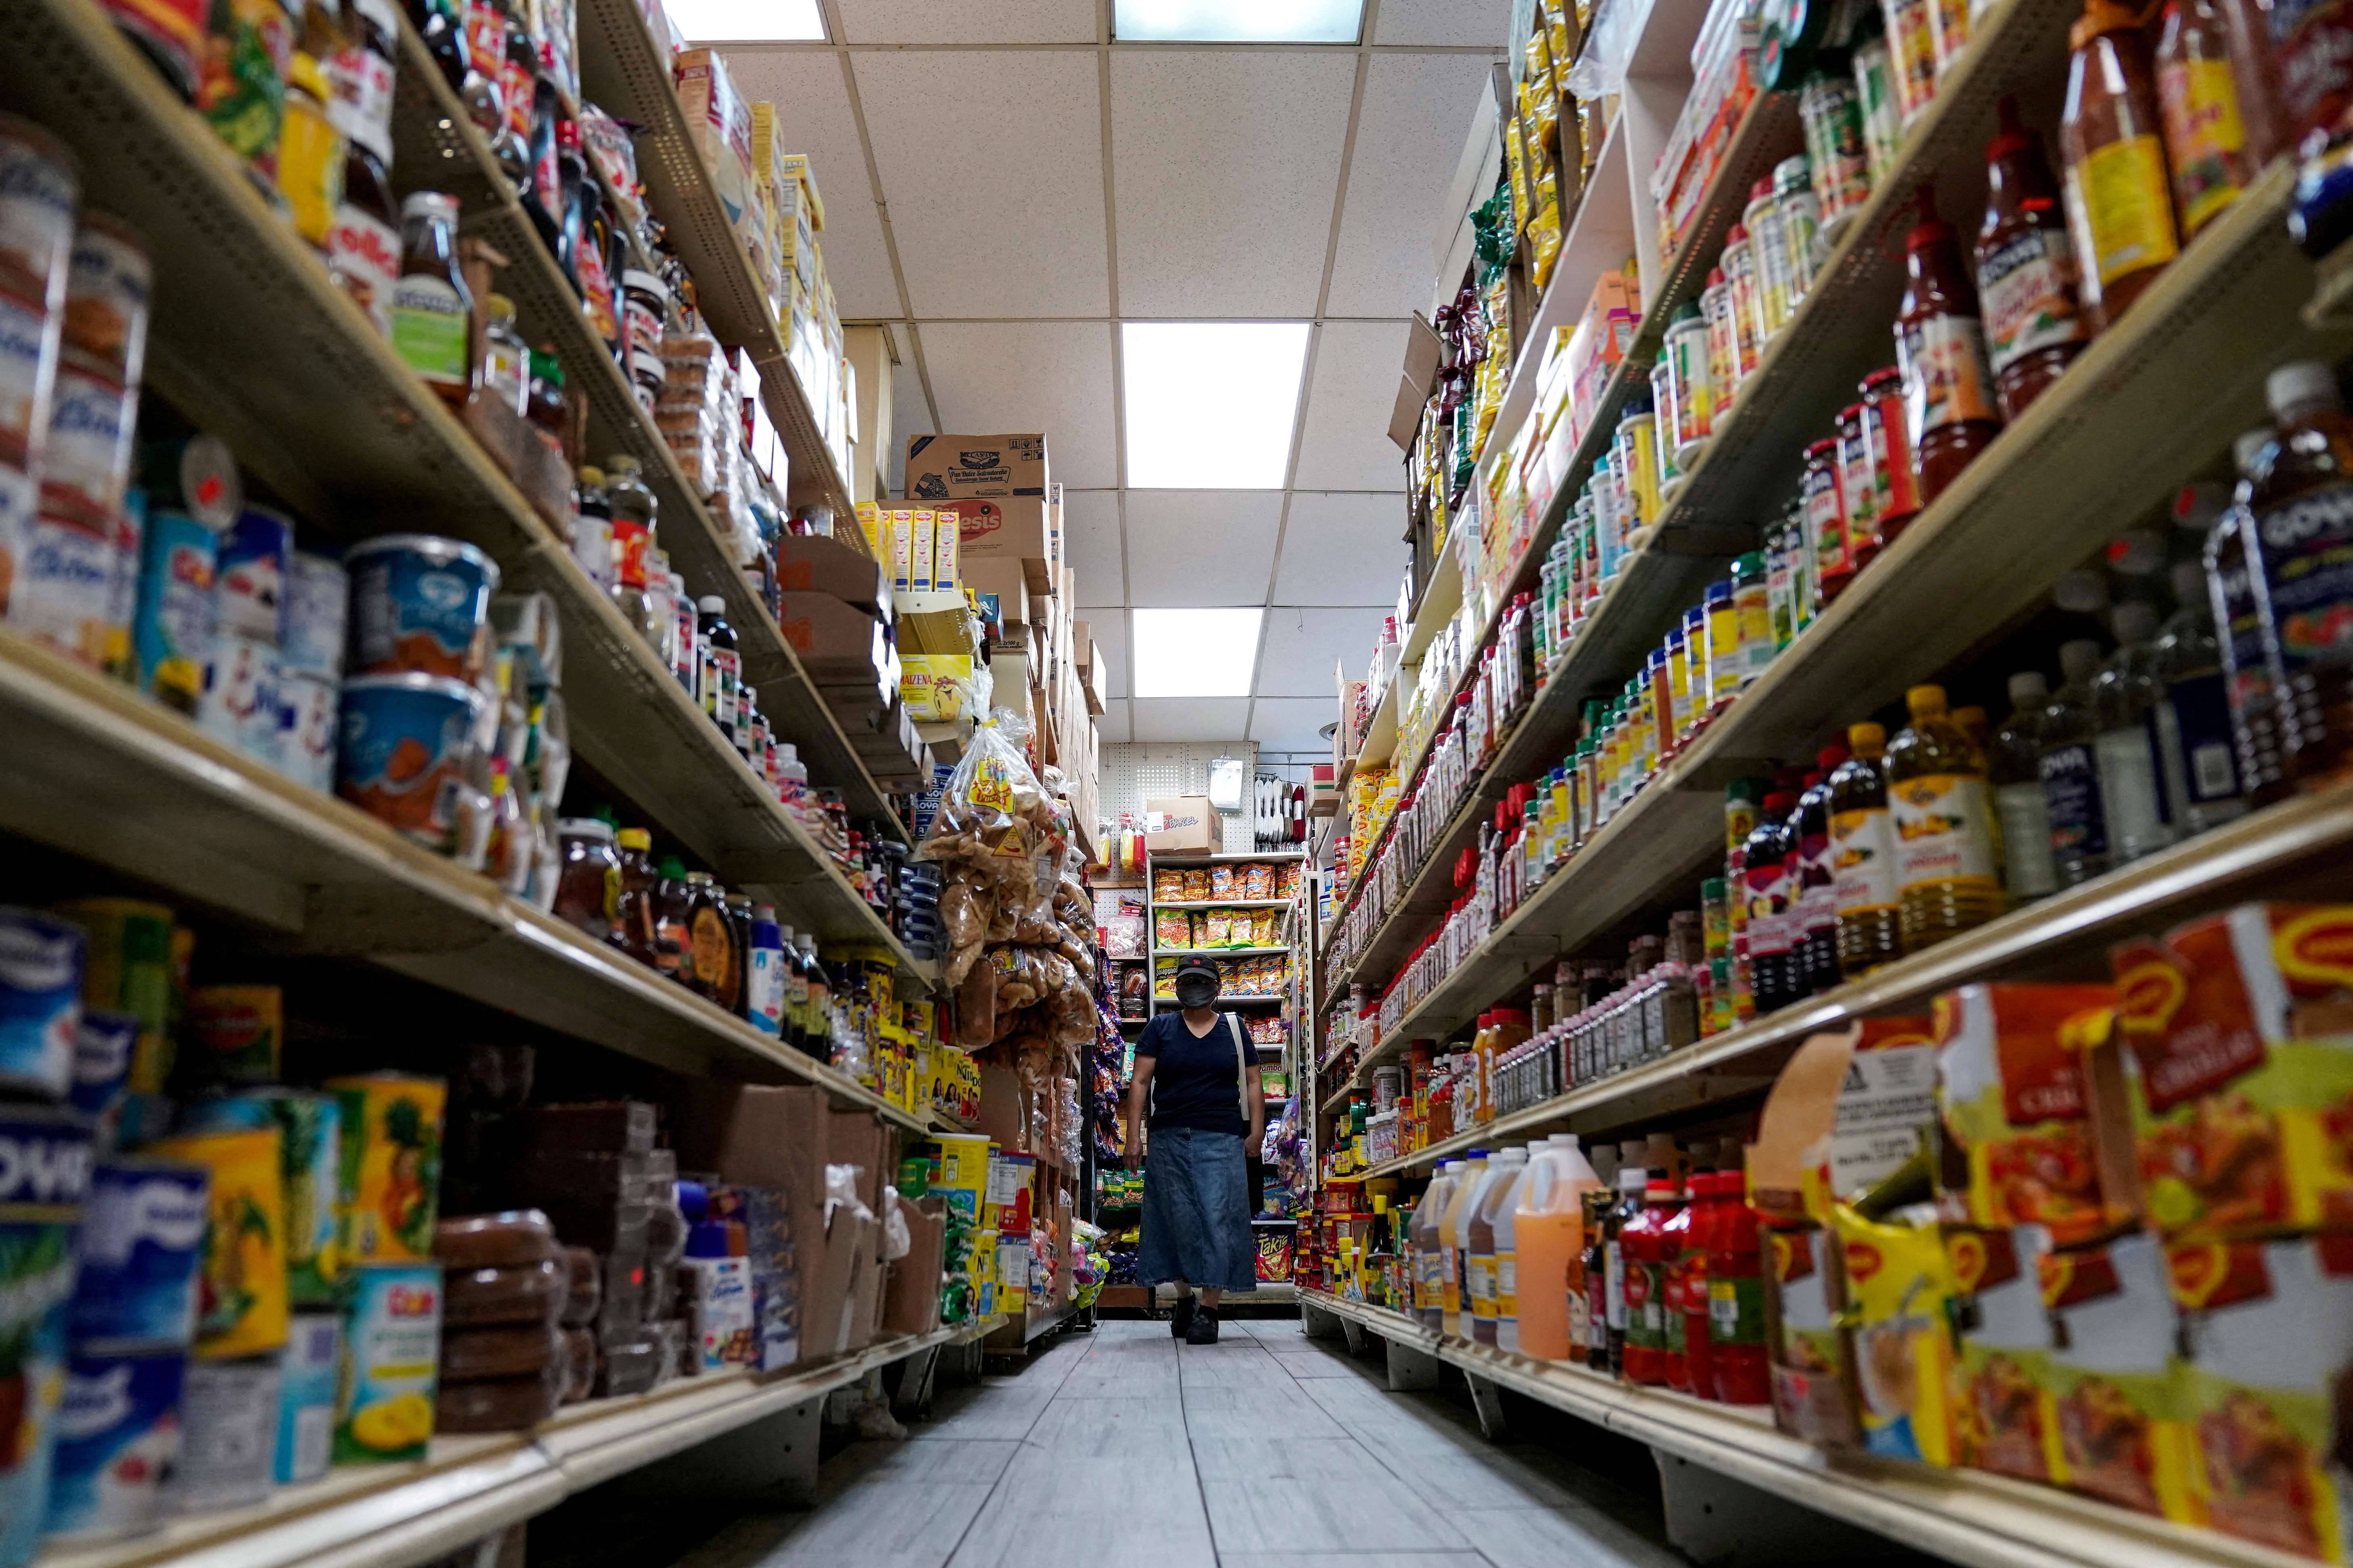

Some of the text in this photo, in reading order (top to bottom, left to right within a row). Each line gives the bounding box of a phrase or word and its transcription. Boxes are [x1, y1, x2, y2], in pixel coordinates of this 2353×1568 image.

[960, 515, 1000, 530] esis
[1169, 816, 1198, 829] BARCEL
[1259, 1064, 1282, 1072] zambo
[1258, 1235, 1288, 1258] Takis
